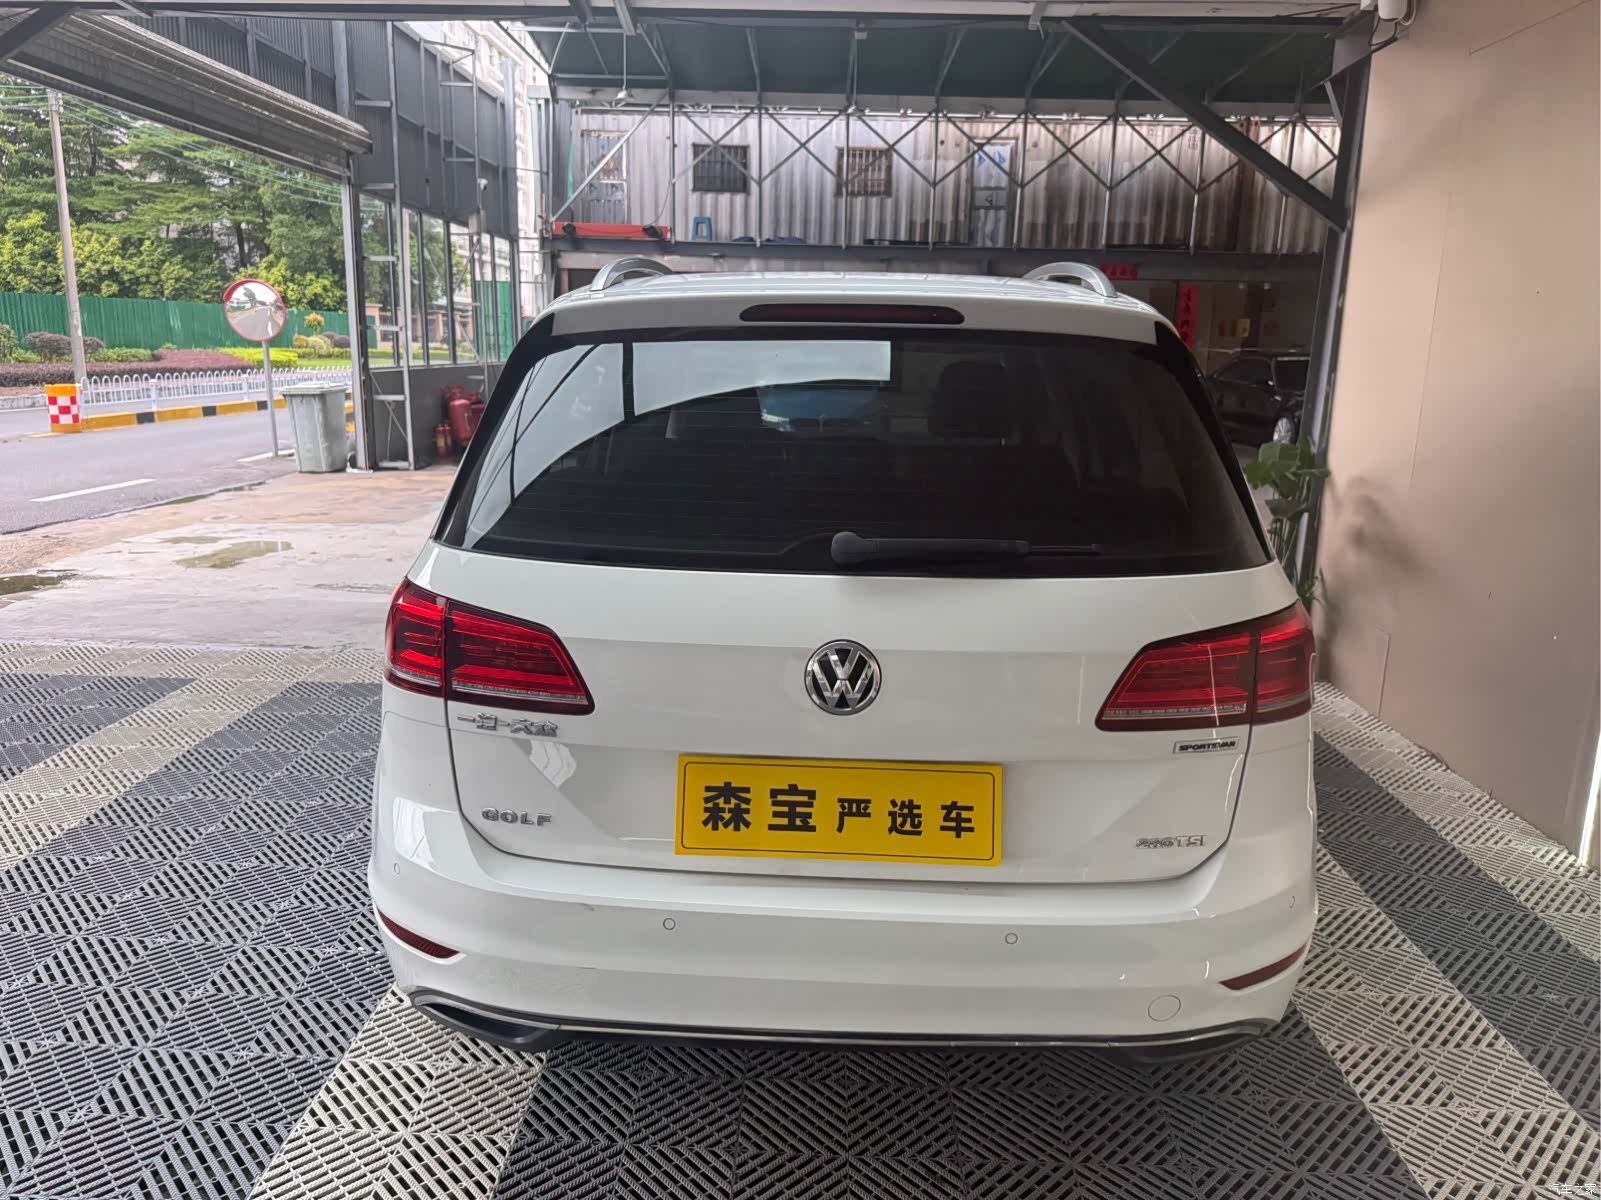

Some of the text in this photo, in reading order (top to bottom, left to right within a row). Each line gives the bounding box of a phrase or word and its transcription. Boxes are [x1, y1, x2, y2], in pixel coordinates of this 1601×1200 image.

[481, 808, 552, 826] GOLF
[702, 782, 975, 839] 森宝严选车
